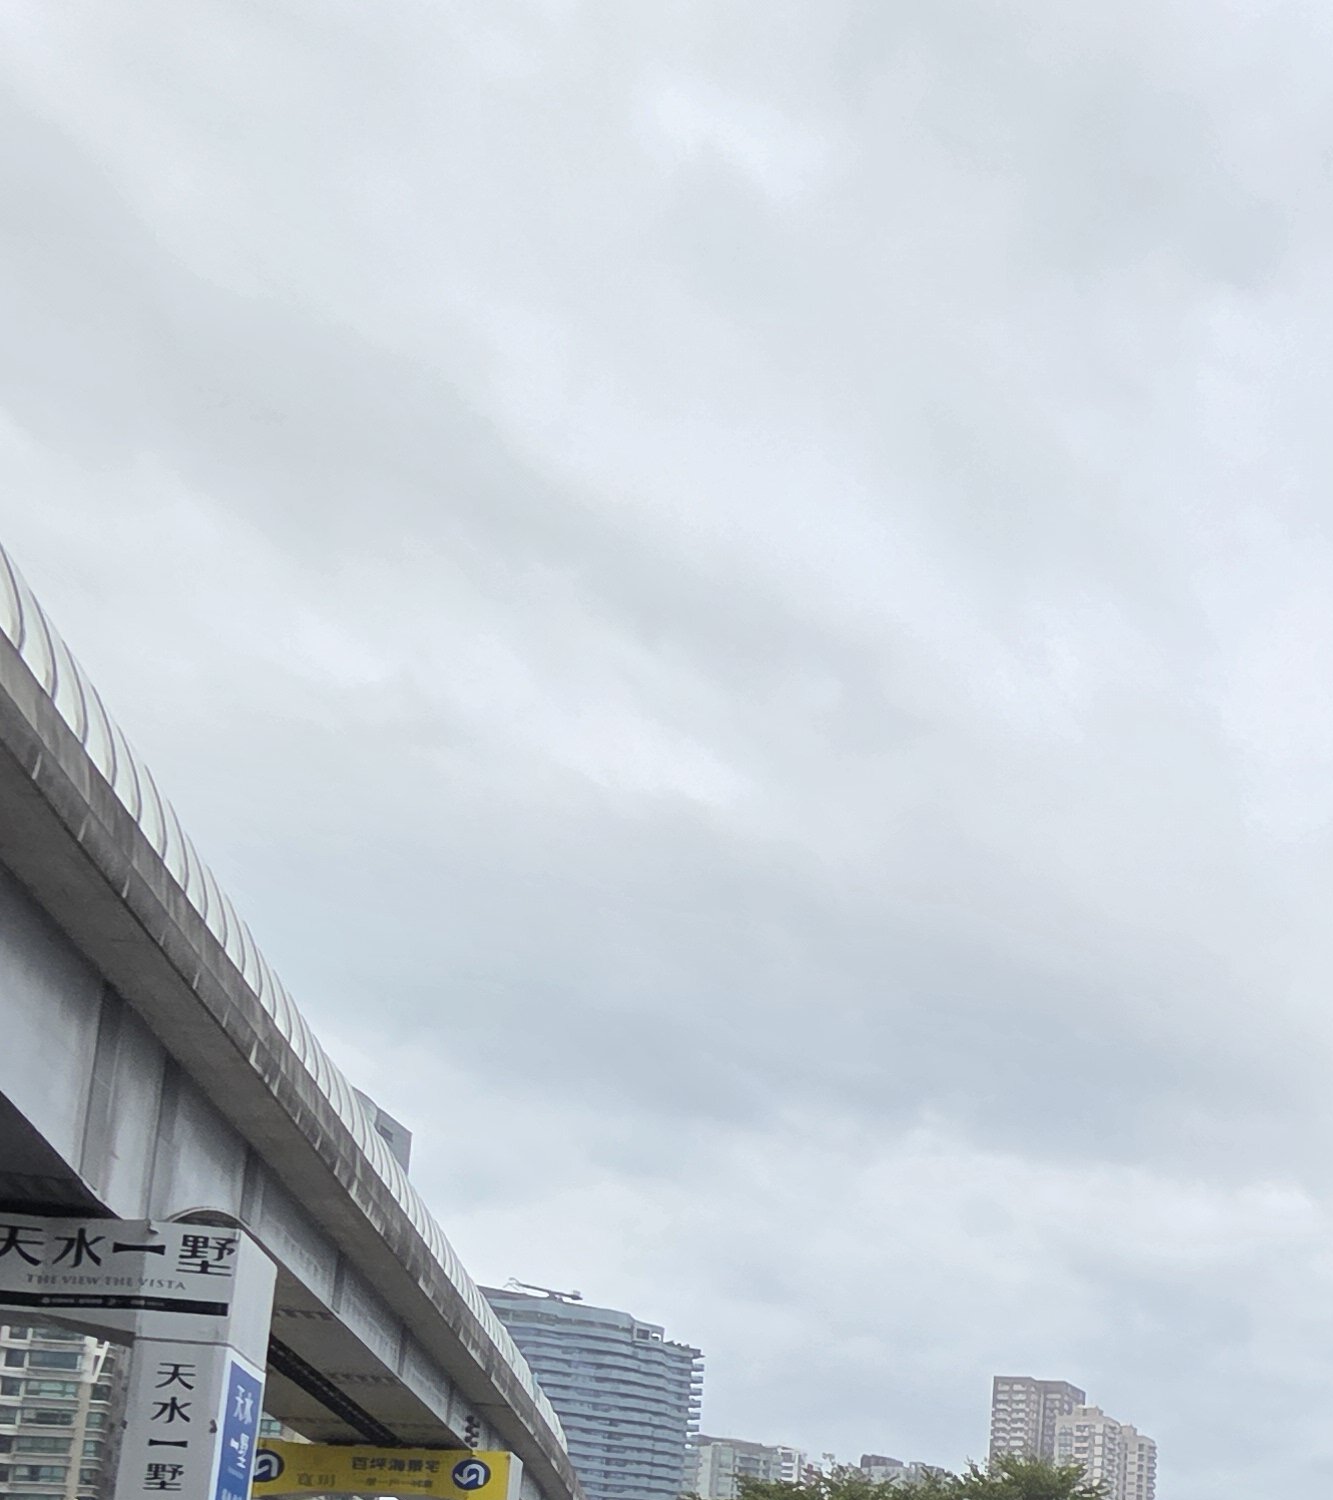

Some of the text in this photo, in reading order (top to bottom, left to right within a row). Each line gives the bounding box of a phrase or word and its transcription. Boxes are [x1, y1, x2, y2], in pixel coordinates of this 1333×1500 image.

[0, 1225, 237, 1277] 天水一墅
[26, 1273, 187, 1291] THE VIEW THE VISTA
[142, 1362, 197, 1491] 天水一墅
